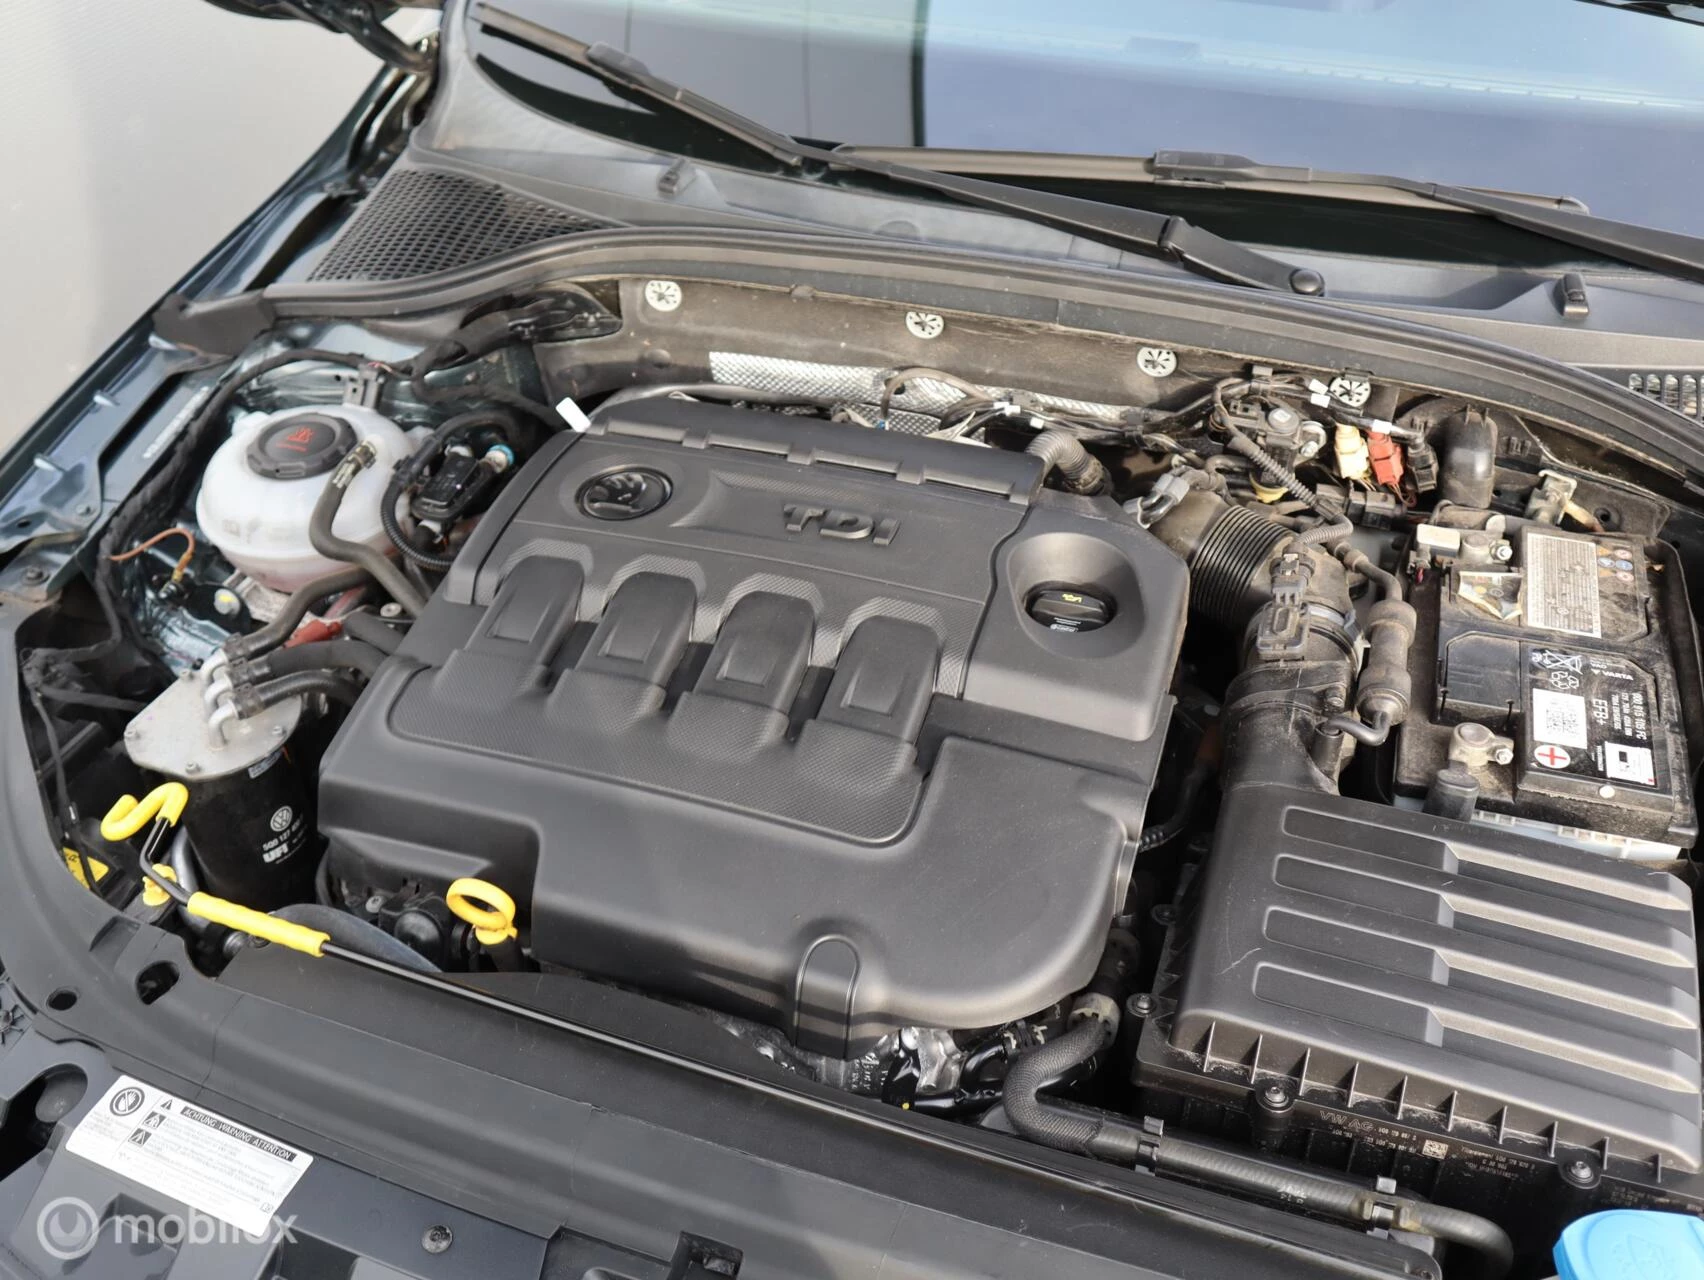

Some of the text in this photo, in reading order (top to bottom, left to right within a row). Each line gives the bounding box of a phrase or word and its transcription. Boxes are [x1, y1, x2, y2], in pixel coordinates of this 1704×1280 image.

[783, 503, 901, 546] TDI
[1602, 670, 1634, 680] VARTA
[1320, 1110, 1347, 1125] VW
[183, 1107, 217, 1127] ACHTUNG
[219, 1121, 252, 1142] WARNING
[253, 1136, 292, 1160] ATTENTION
